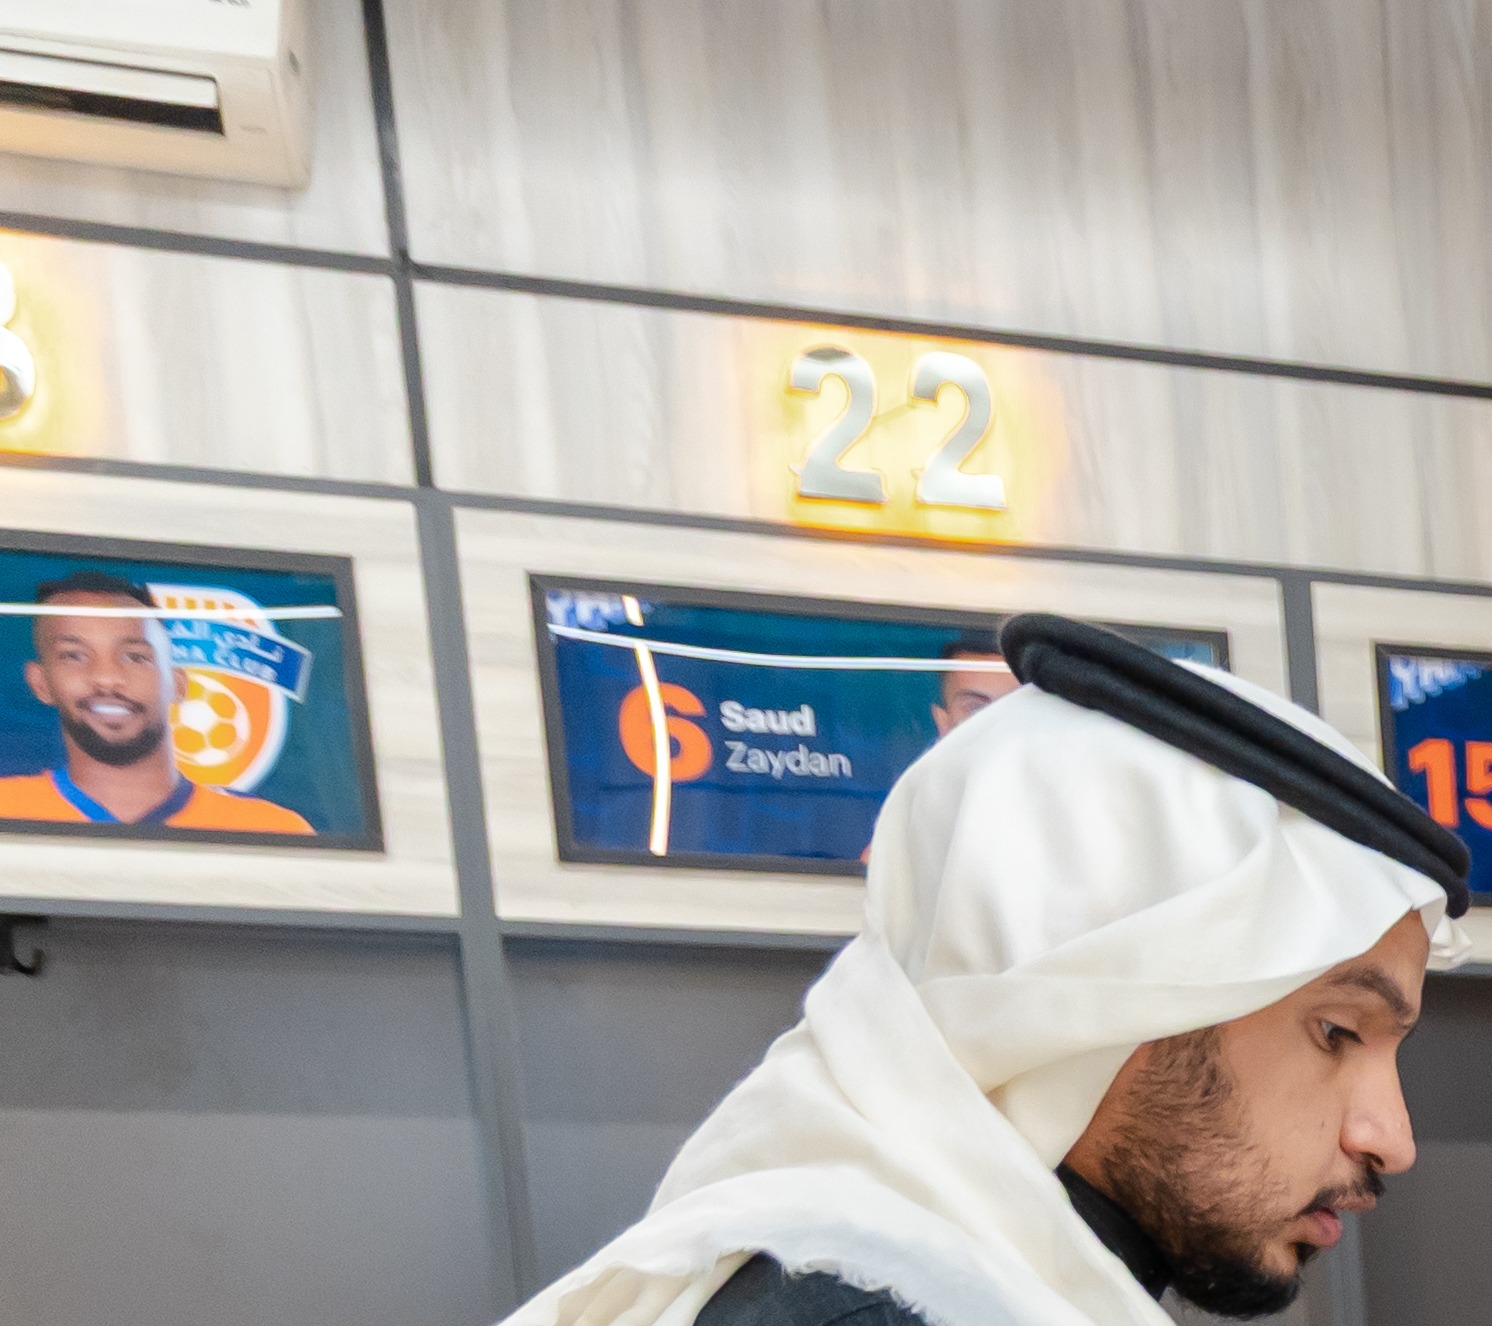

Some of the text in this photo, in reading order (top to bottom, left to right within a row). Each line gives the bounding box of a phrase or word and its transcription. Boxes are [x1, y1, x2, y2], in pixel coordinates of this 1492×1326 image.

[790, 344, 1008, 511] 22
[617, 681, 714, 784] 6
[719, 699, 818, 738] Saud
[723, 740, 853, 780] Zaydan
